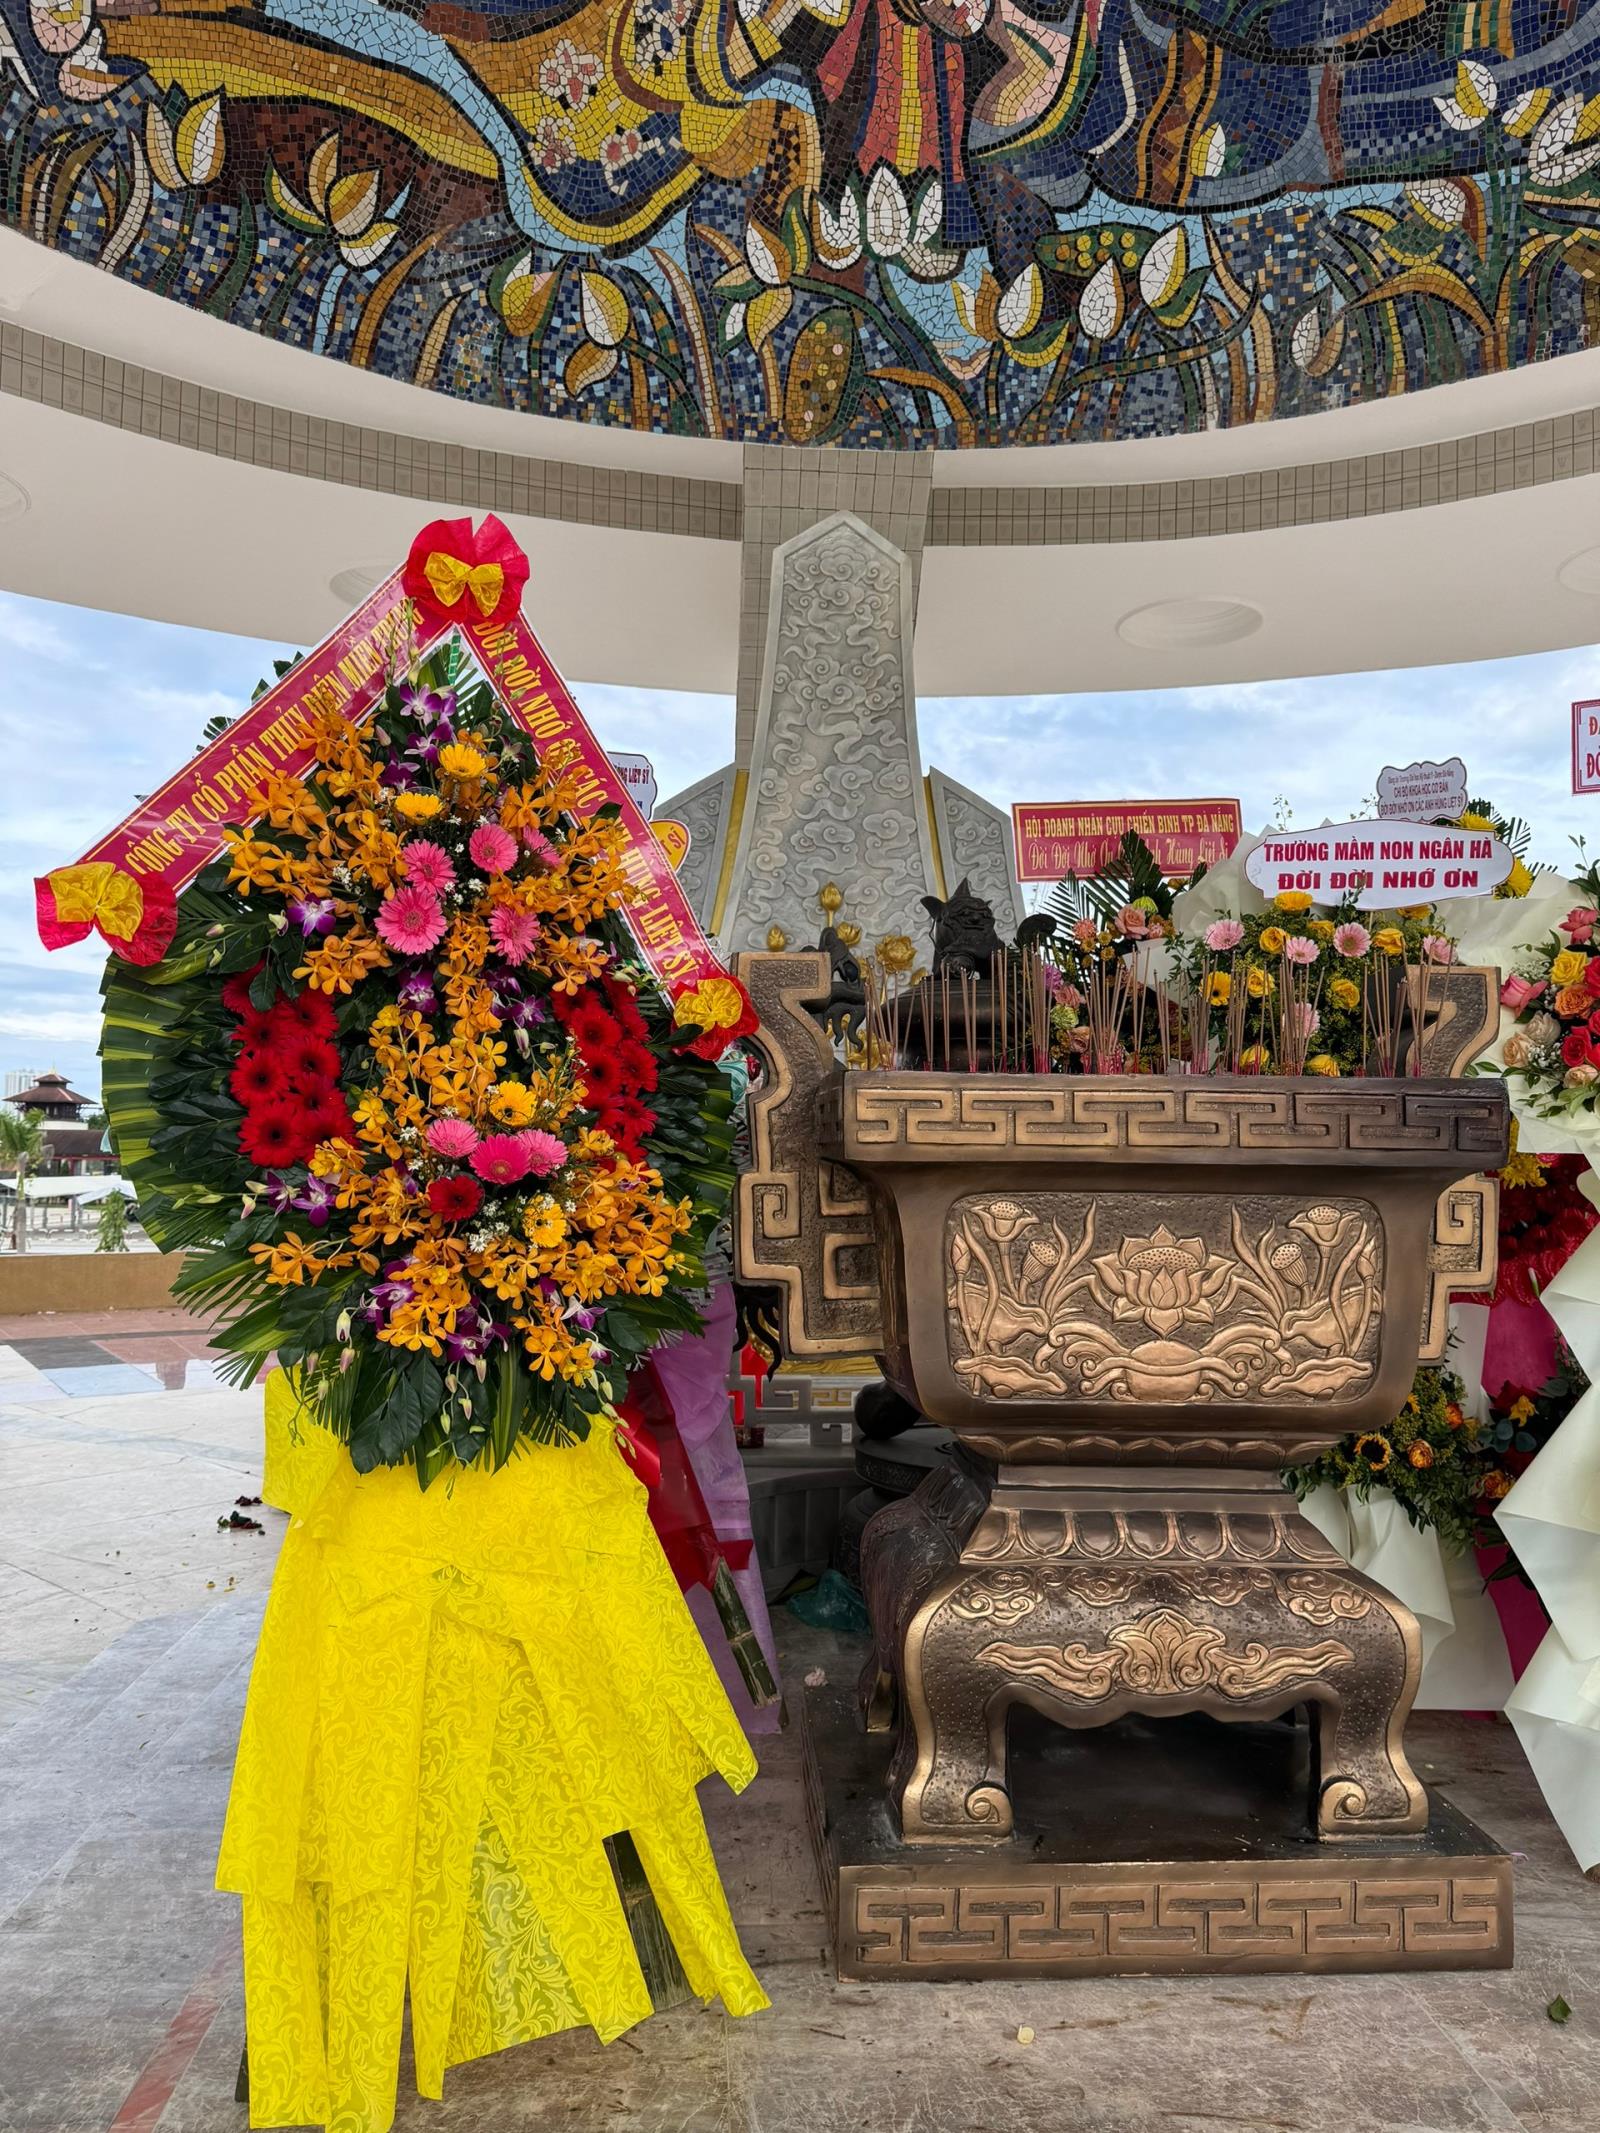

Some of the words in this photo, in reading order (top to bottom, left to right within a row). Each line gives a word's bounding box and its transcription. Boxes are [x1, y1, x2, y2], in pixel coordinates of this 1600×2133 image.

[125, 827, 184, 875] CÔNG
[165, 804, 206, 844] TY
[191, 772, 229, 822] CỔ
[213, 743, 275, 803] PHẦN
[337, 635, 384, 692] MIỀN
[518, 692, 574, 739] NHỚ
[639, 903, 685, 953] LIỆT
[1024, 815, 1041, 843] HỘI
[1044, 817, 1075, 838] DOANH
[1078, 812, 1102, 836] NHÂN
[1127, 809, 1155, 834] CHIẾN
[1158, 815, 1180, 833] BINH
[1182, 815, 1194, 833] TP
[1197, 811, 1215, 833] ĐÀ
[1216, 807, 1234, 833] NẴNG
[1264, 840, 1329, 862] TRƯỜNG
[1334, 836, 1374, 861] MẦM
[1380, 841, 1414, 860] NON
[1419, 837, 1465, 860] NGÂN
[1469, 837, 1493, 859] HÀ
[1277, 870, 1321, 890] ĐỜI
[1330, 869, 1374, 889] ĐỜI
[1382, 868, 1436, 889] NHỚ
[1443, 868, 1479, 888] ƠN
